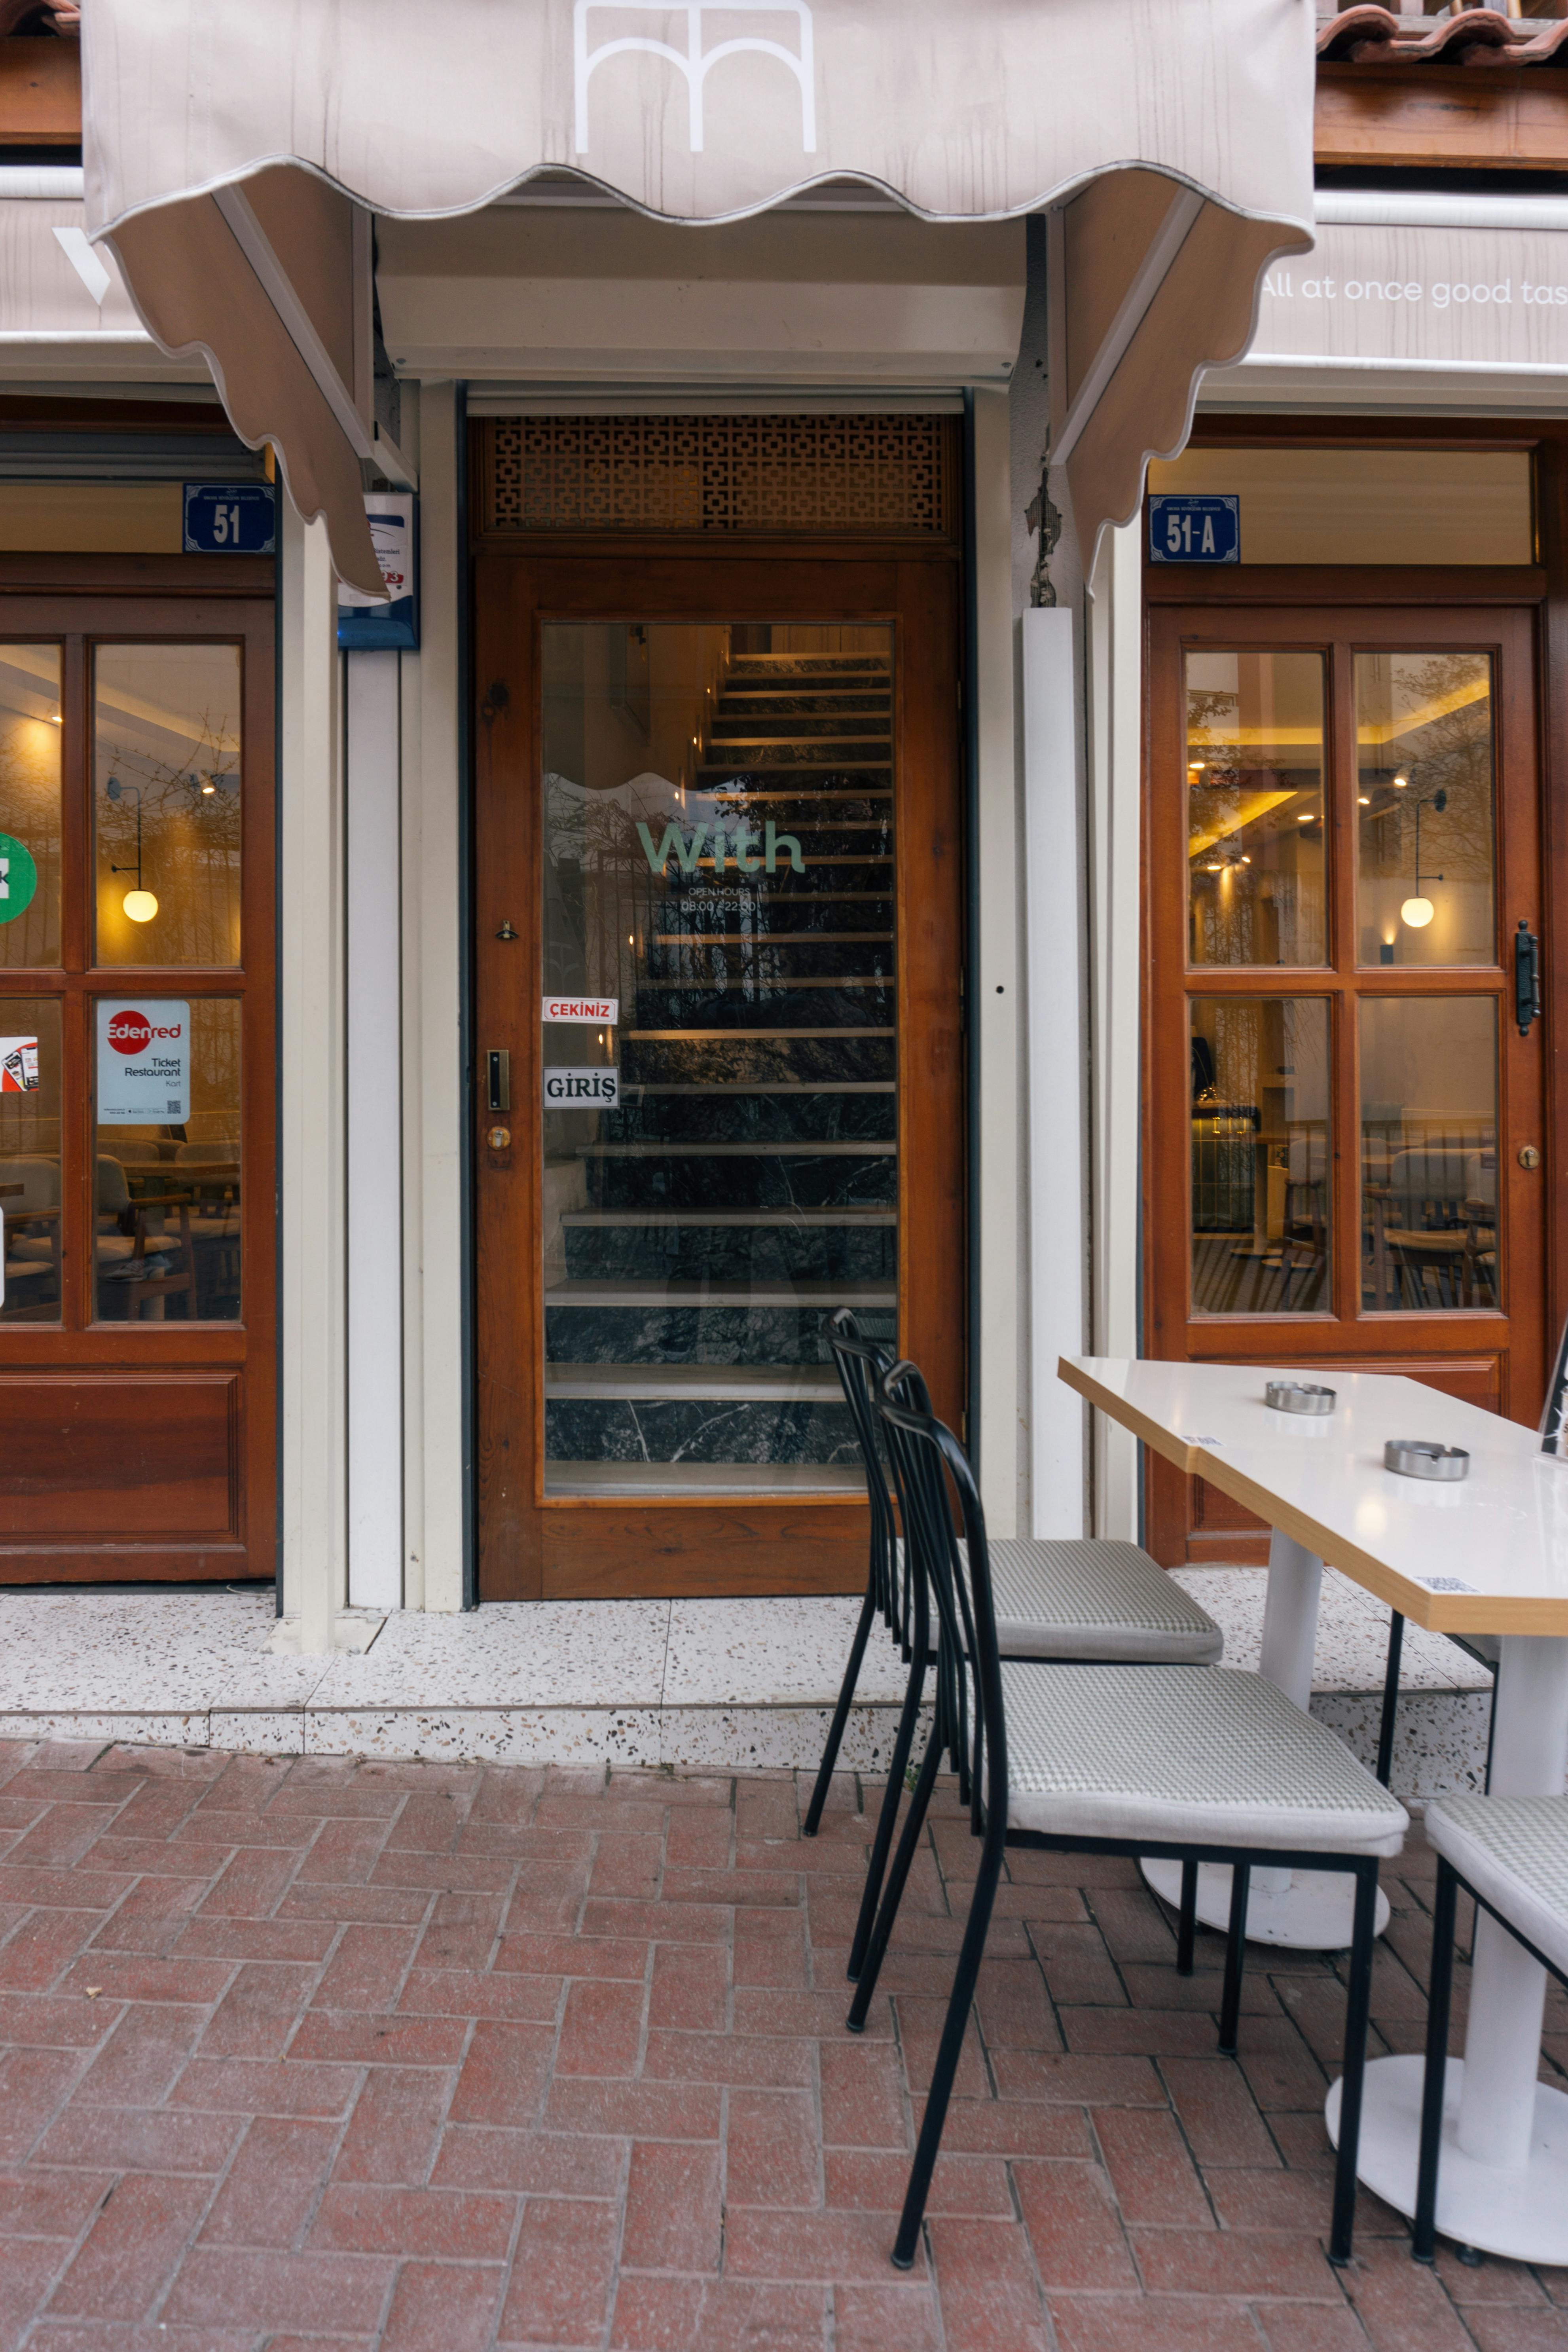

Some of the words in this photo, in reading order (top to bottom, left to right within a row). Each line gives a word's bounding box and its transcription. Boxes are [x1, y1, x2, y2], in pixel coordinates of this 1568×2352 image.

[1262, 272, 1293, 297] All
[1302, 276, 1336, 298] at
[1344, 281, 1423, 301] once
[1431, 278, 1512, 308] good
[213, 505, 239, 543] 51
[1167, 515, 1215, 553] 51-A
[635, 821, 806, 873] With
[688, 888, 715, 896] OPEN
[717, 888, 751, 896] HOURS
[681, 901, 714, 912] 08:00
[724, 901, 756, 912] 22:00
[550, 1001, 610, 1017] ÇEKİNİZ
[108, 1024, 181, 1039] Edenred
[151, 1058, 181, 1067] Ticket
[125, 1068, 181, 1076] Restaurant
[547, 1073, 616, 1103] GİRİŞ
